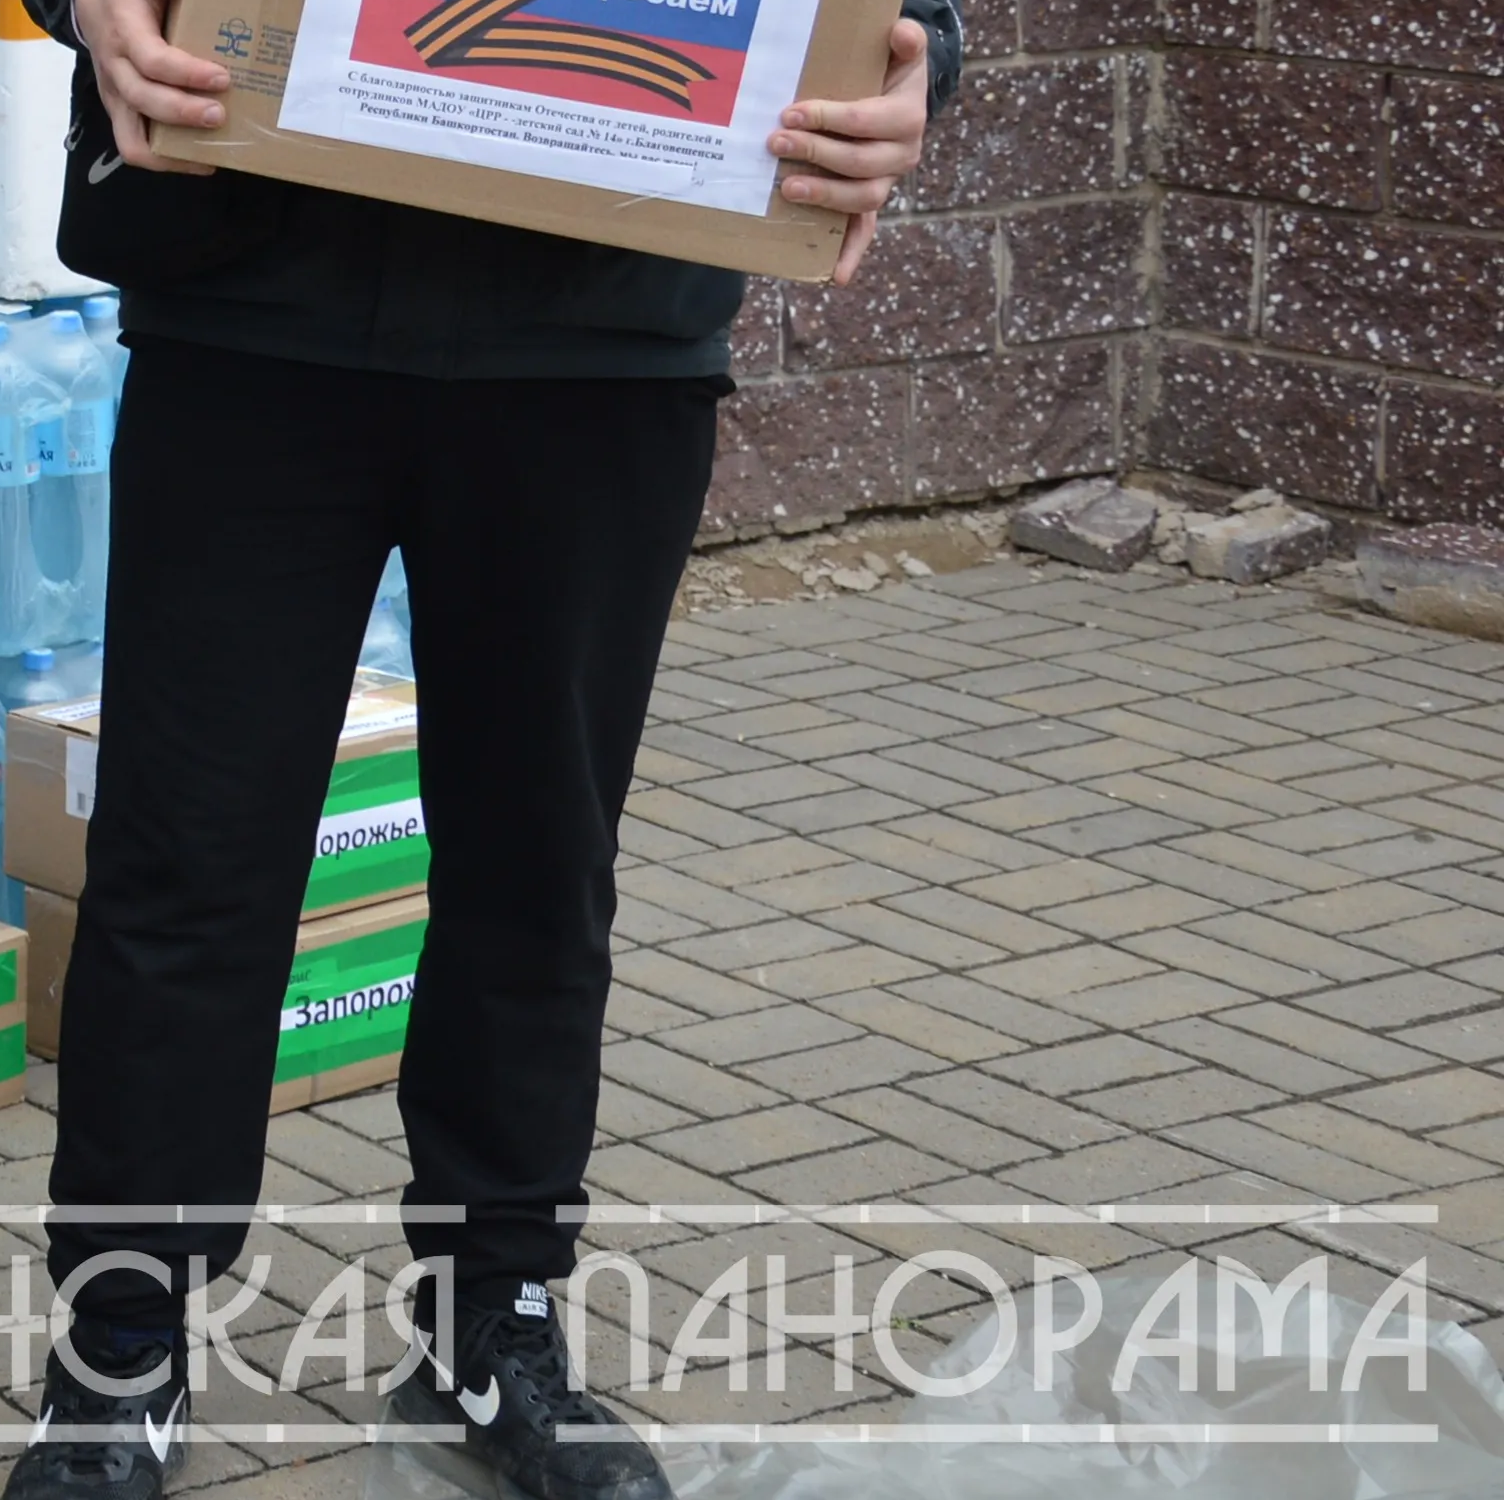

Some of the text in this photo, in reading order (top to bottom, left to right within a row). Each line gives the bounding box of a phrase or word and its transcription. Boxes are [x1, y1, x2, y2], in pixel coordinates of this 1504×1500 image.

[339, 85, 413, 106] сотрудников
[417, 97, 466, 116] МАДОУ
[565, 127, 584, 137] сад
[360, 73, 455, 99] благодарностью
[459, 92, 531, 112] защитникам
[535, 104, 595, 124] Отечества
[598, 118, 612, 126] от
[652, 128, 712, 146] родителей
[360, 102, 429, 124] Республики
[521, 1281, 548, 1304] NIKE
